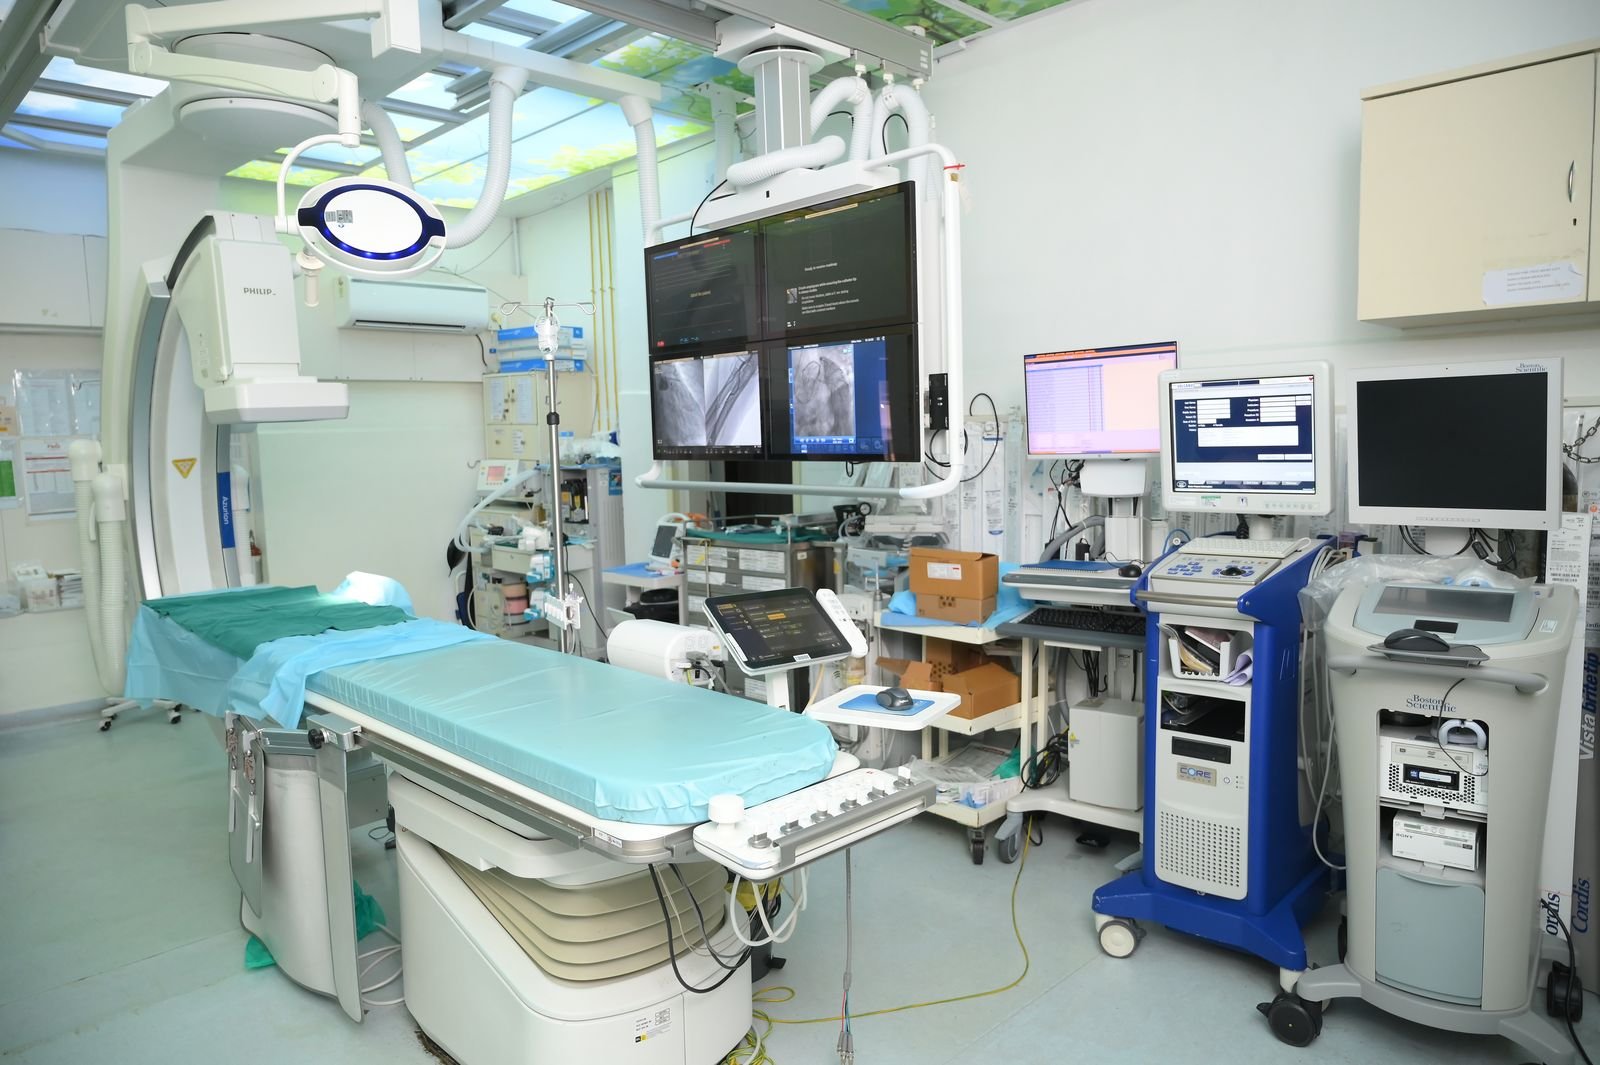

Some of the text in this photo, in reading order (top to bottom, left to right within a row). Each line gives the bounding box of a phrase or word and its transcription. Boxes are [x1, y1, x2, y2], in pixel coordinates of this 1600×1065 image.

[243, 287, 277, 296] PHILIP
[1413, 694, 1444, 706] Boston
[1180, 767, 1211, 778] CORE
[1572, 878, 1590, 933] Cordis
